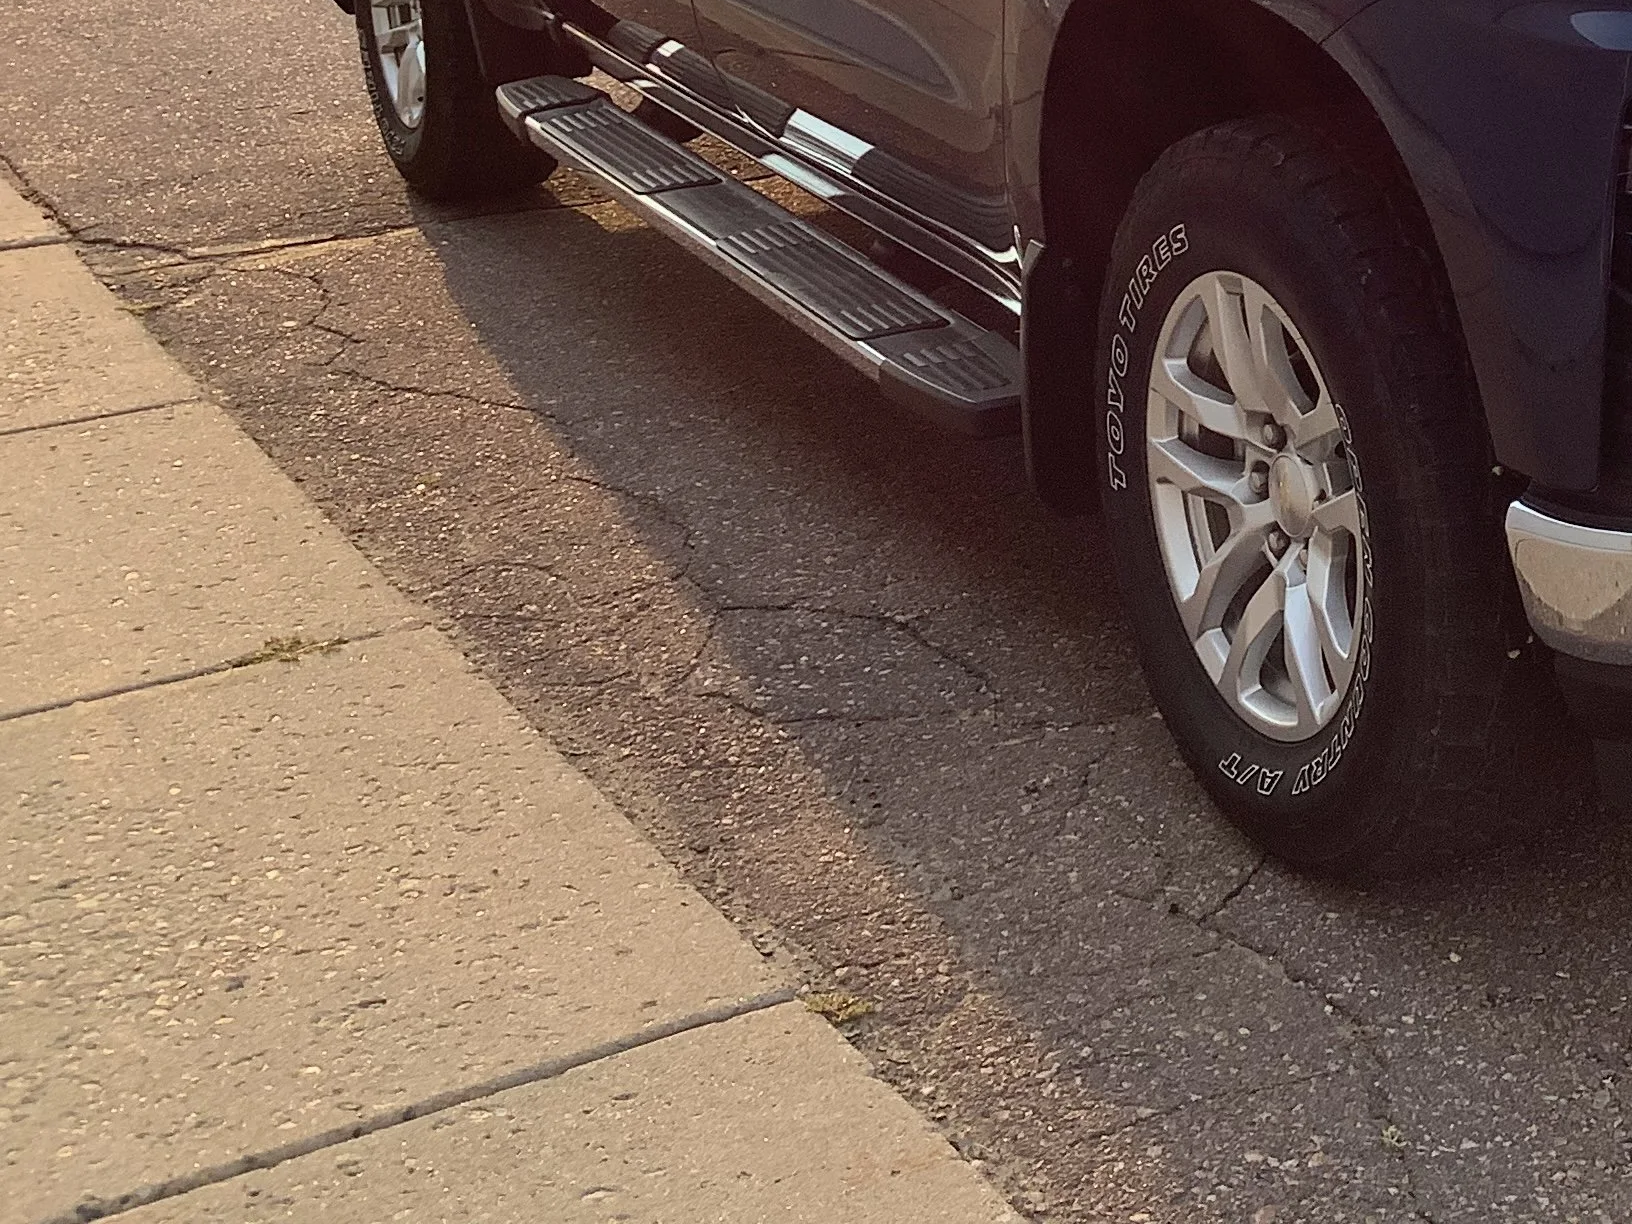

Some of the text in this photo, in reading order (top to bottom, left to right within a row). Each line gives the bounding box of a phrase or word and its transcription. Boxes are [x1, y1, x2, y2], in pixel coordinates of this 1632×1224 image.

[1107, 224, 1188, 490] TOYO TIRES
[1208, 752, 1283, 796] A/T
[1291, 596, 1374, 795] COUNTRY
